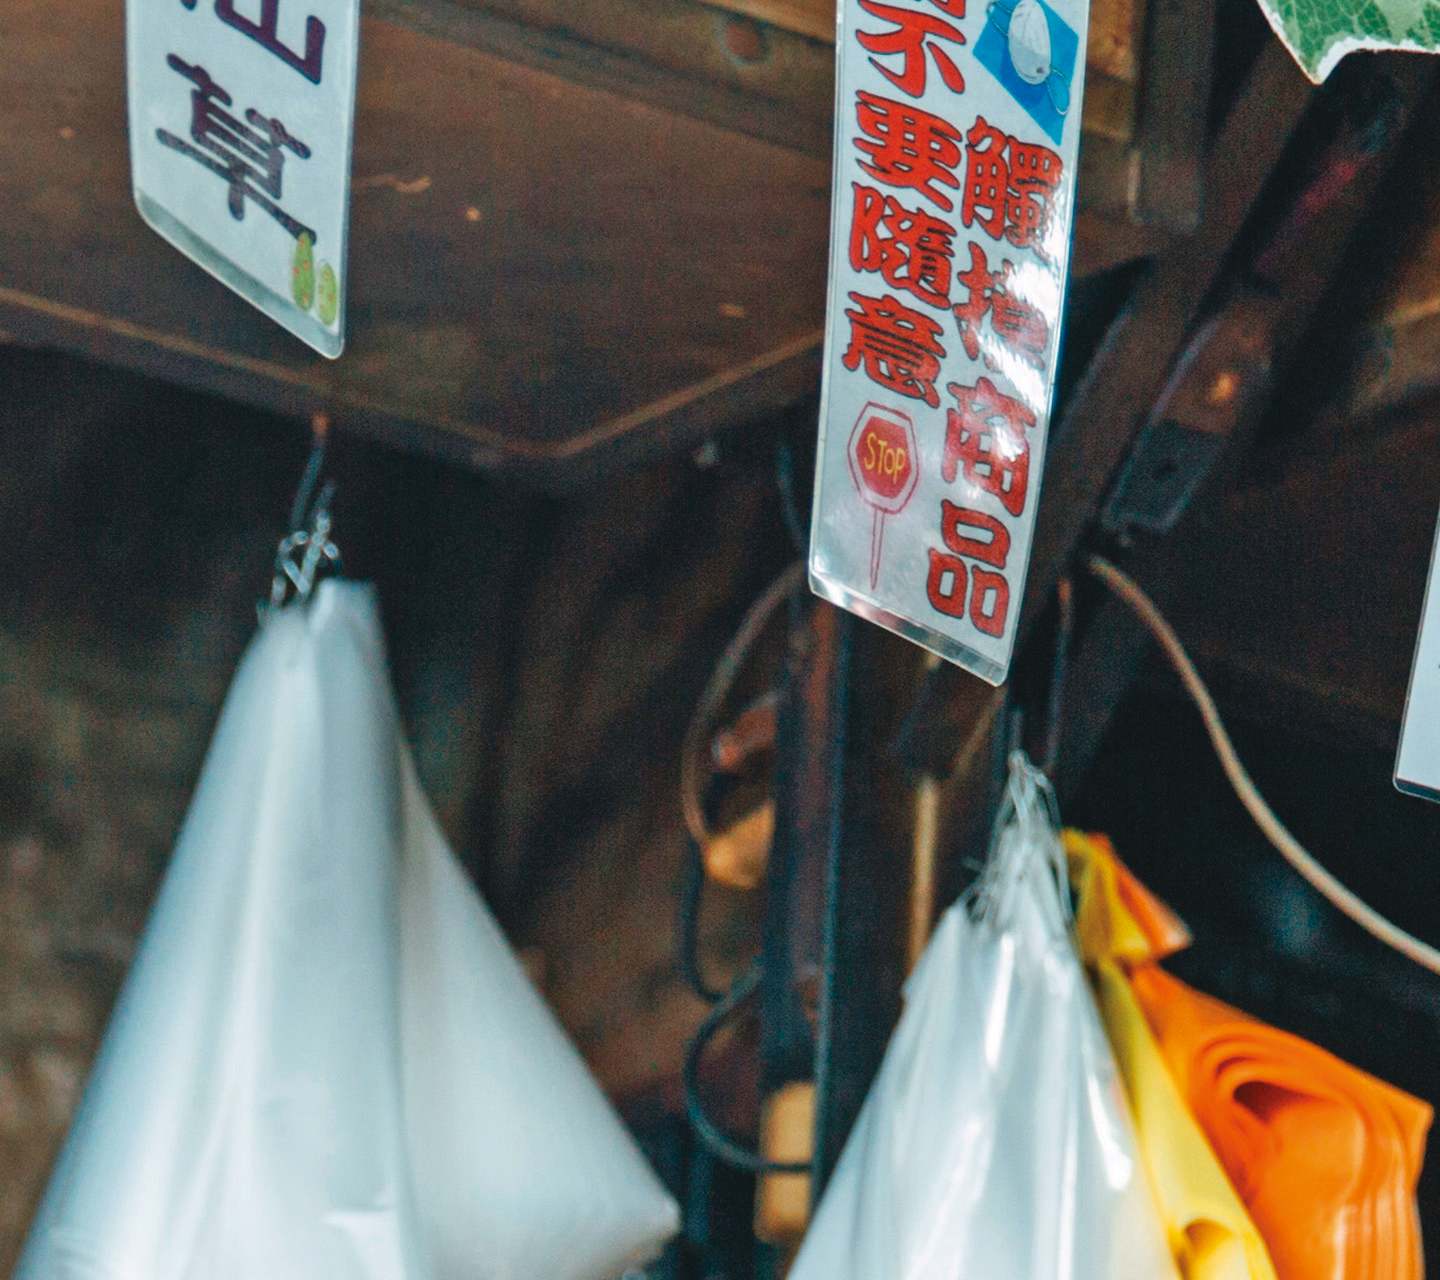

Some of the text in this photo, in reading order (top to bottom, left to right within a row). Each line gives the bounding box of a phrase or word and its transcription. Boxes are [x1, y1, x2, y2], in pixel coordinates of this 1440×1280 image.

[841, 0, 967, 409] 不要隨意
[864, 432, 906, 484] STOP
